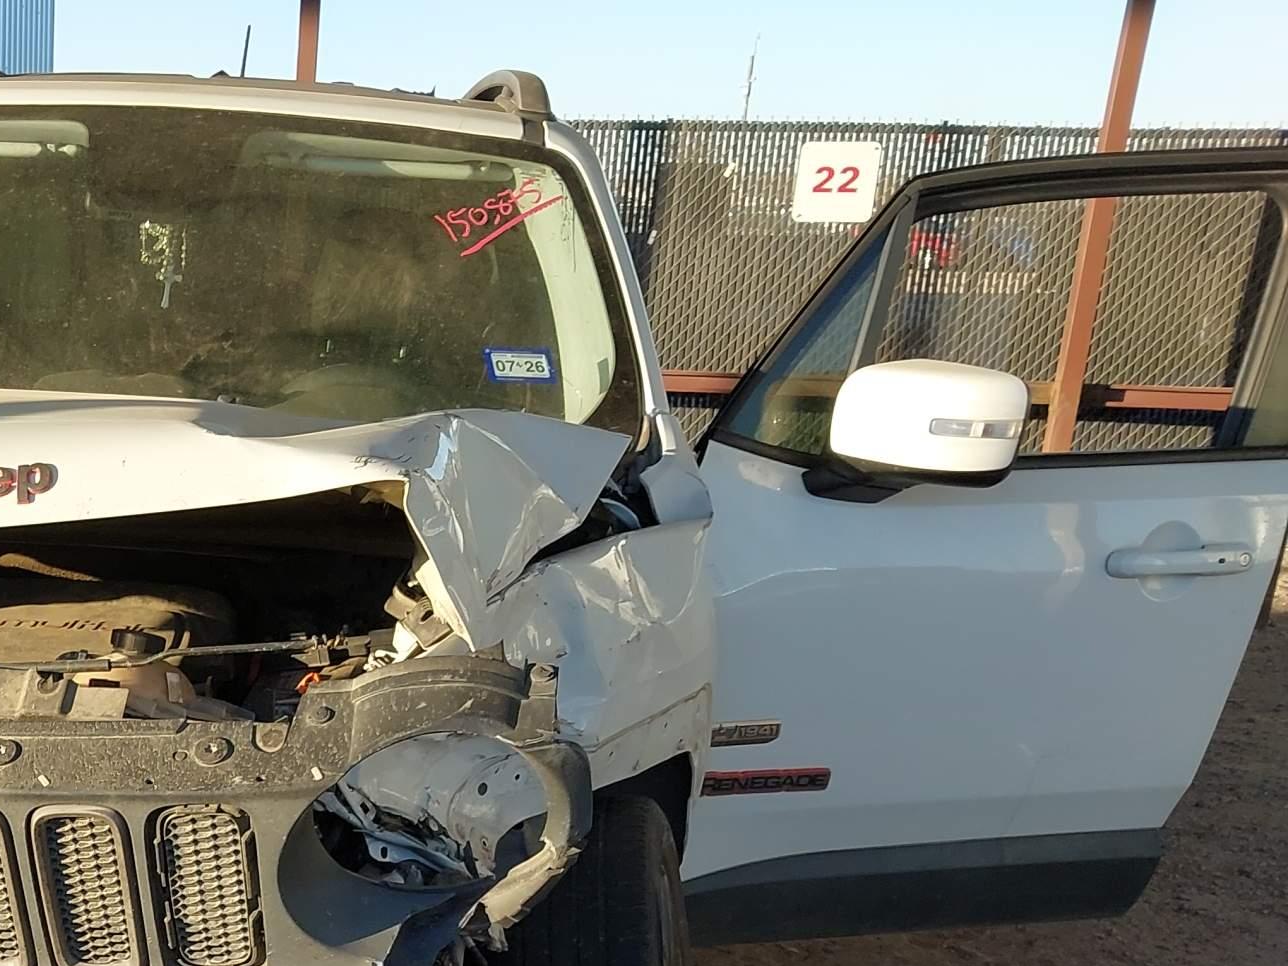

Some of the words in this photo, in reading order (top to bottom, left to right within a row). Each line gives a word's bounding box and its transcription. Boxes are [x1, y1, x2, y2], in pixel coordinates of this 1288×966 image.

[812, 166, 860, 193] 22
[495, 359, 515, 372] 07
[524, 360, 546, 373] 26
[704, 774, 828, 791] RENEGADE
